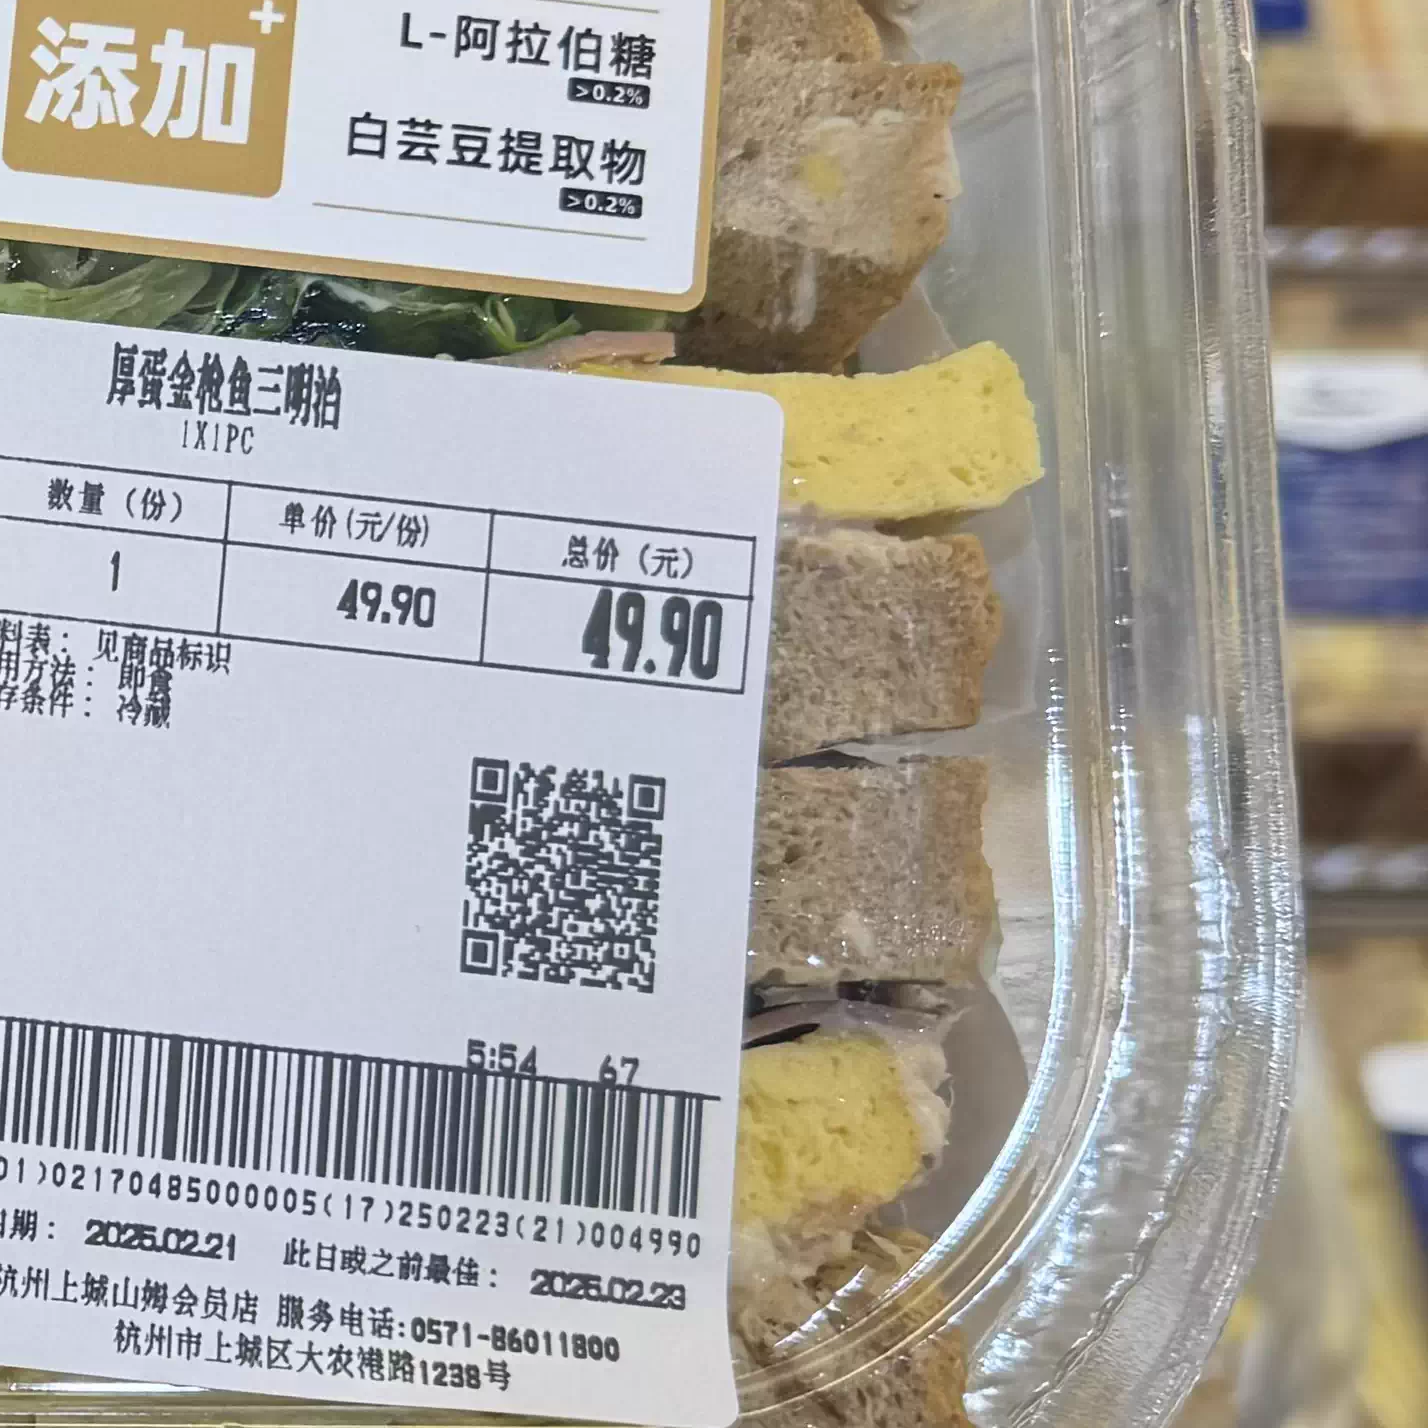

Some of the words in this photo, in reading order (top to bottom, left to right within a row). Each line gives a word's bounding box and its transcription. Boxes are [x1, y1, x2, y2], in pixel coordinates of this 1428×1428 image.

[400, 12, 656, 80] L-阿拉伯糖
[347, 111, 647, 187] 白芸豆提取物
[106, 340, 343, 431] 厚蛋金枪鱼三明治
[110, 550, 121, 592] 1
[336, 578, 437, 629] 49.90
[581, 587, 725, 681] 49.90
[84, 1218, 237, 1262] 2025.02.21
